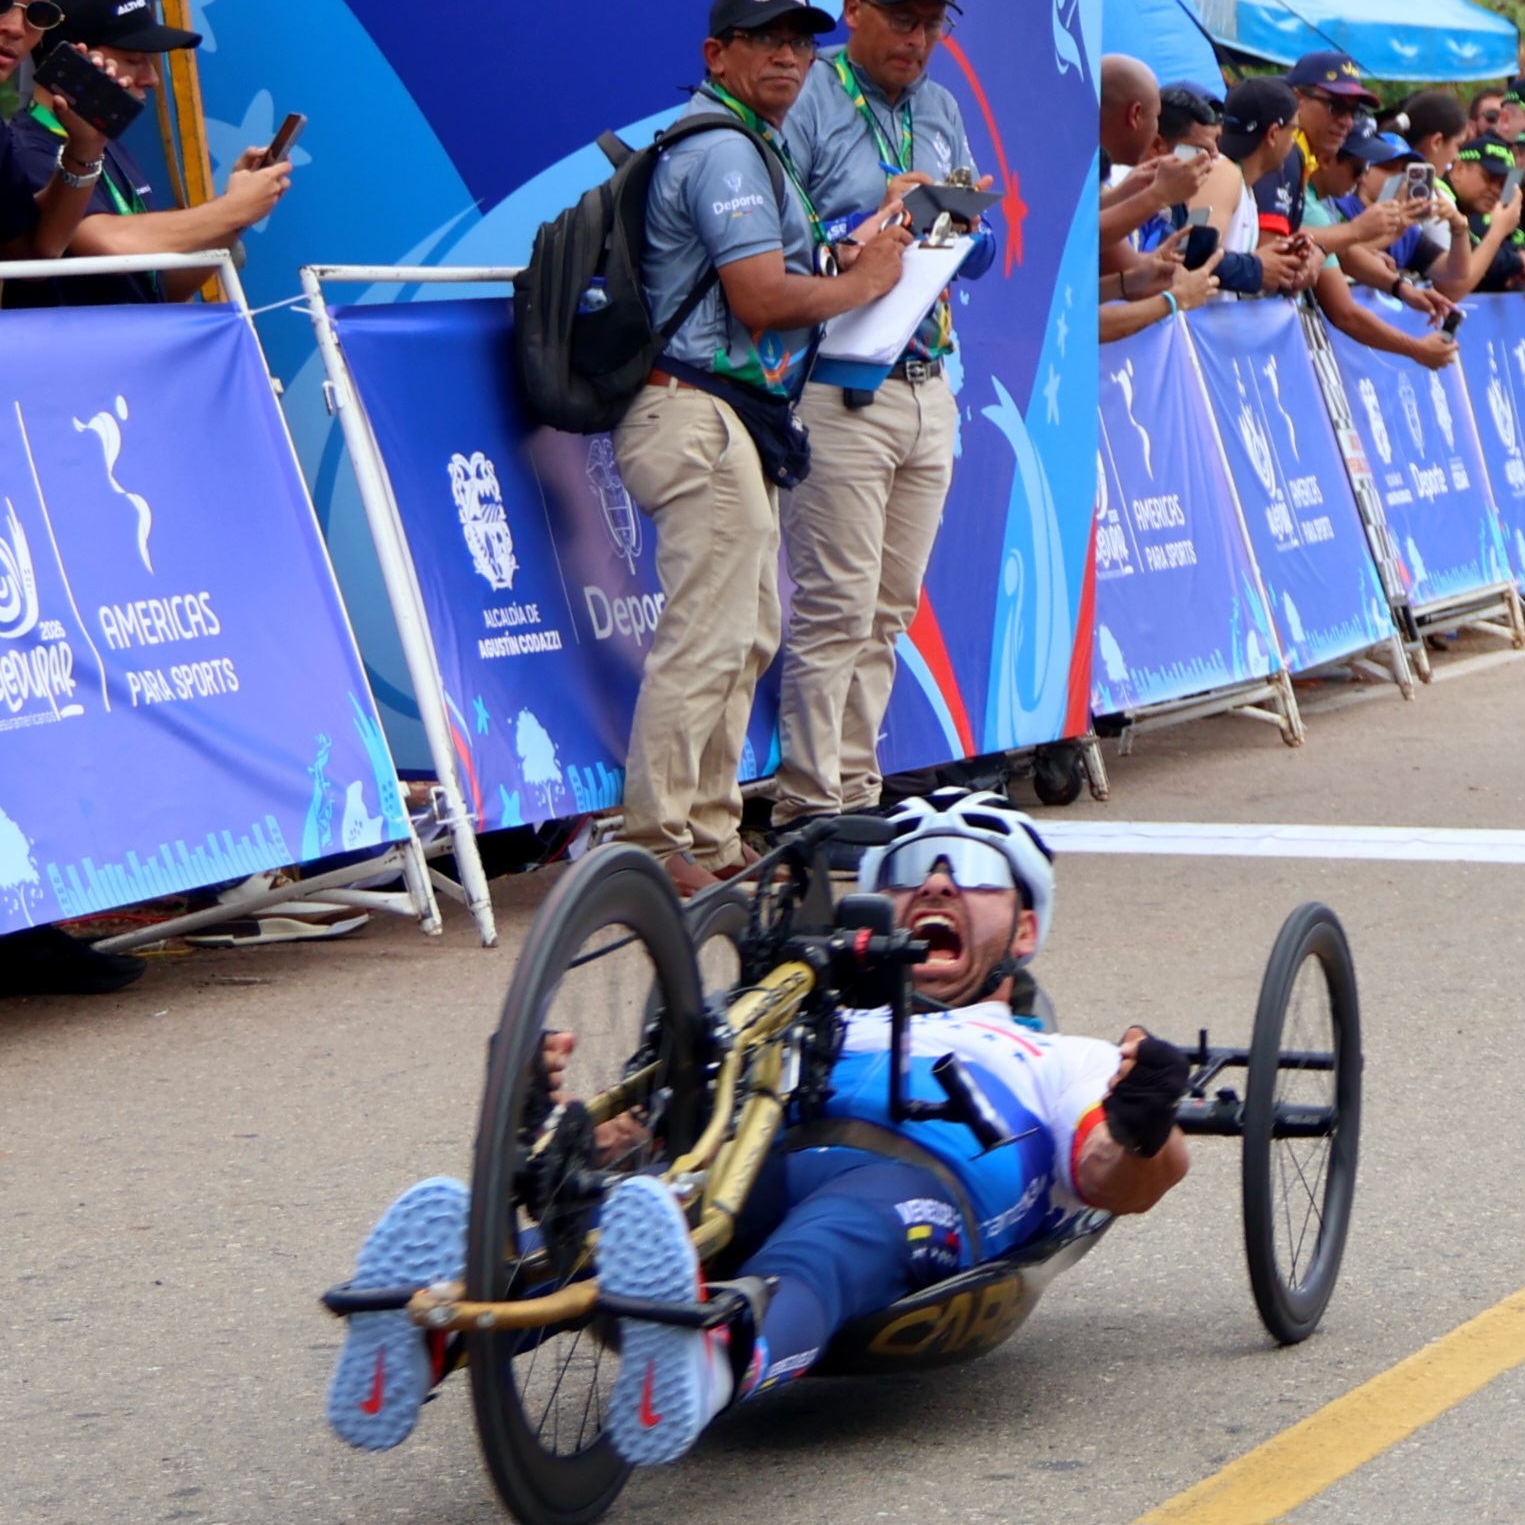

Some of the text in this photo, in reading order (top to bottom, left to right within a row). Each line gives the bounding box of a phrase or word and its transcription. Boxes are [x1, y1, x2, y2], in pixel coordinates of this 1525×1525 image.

[712, 193, 763, 216] Deporte
[1132, 494, 1186, 532] AMERICAS
[1145, 540, 1197, 572] PARA SPORTS
[99, 592, 221, 650] AMERICAS
[483, 601, 541, 629] ALCALDÍA DE
[39, 620, 66, 641] 2026
[478, 630, 563, 659] AGUSTÍN CODAZZI
[126, 658, 240, 707] PARA SPORTS
